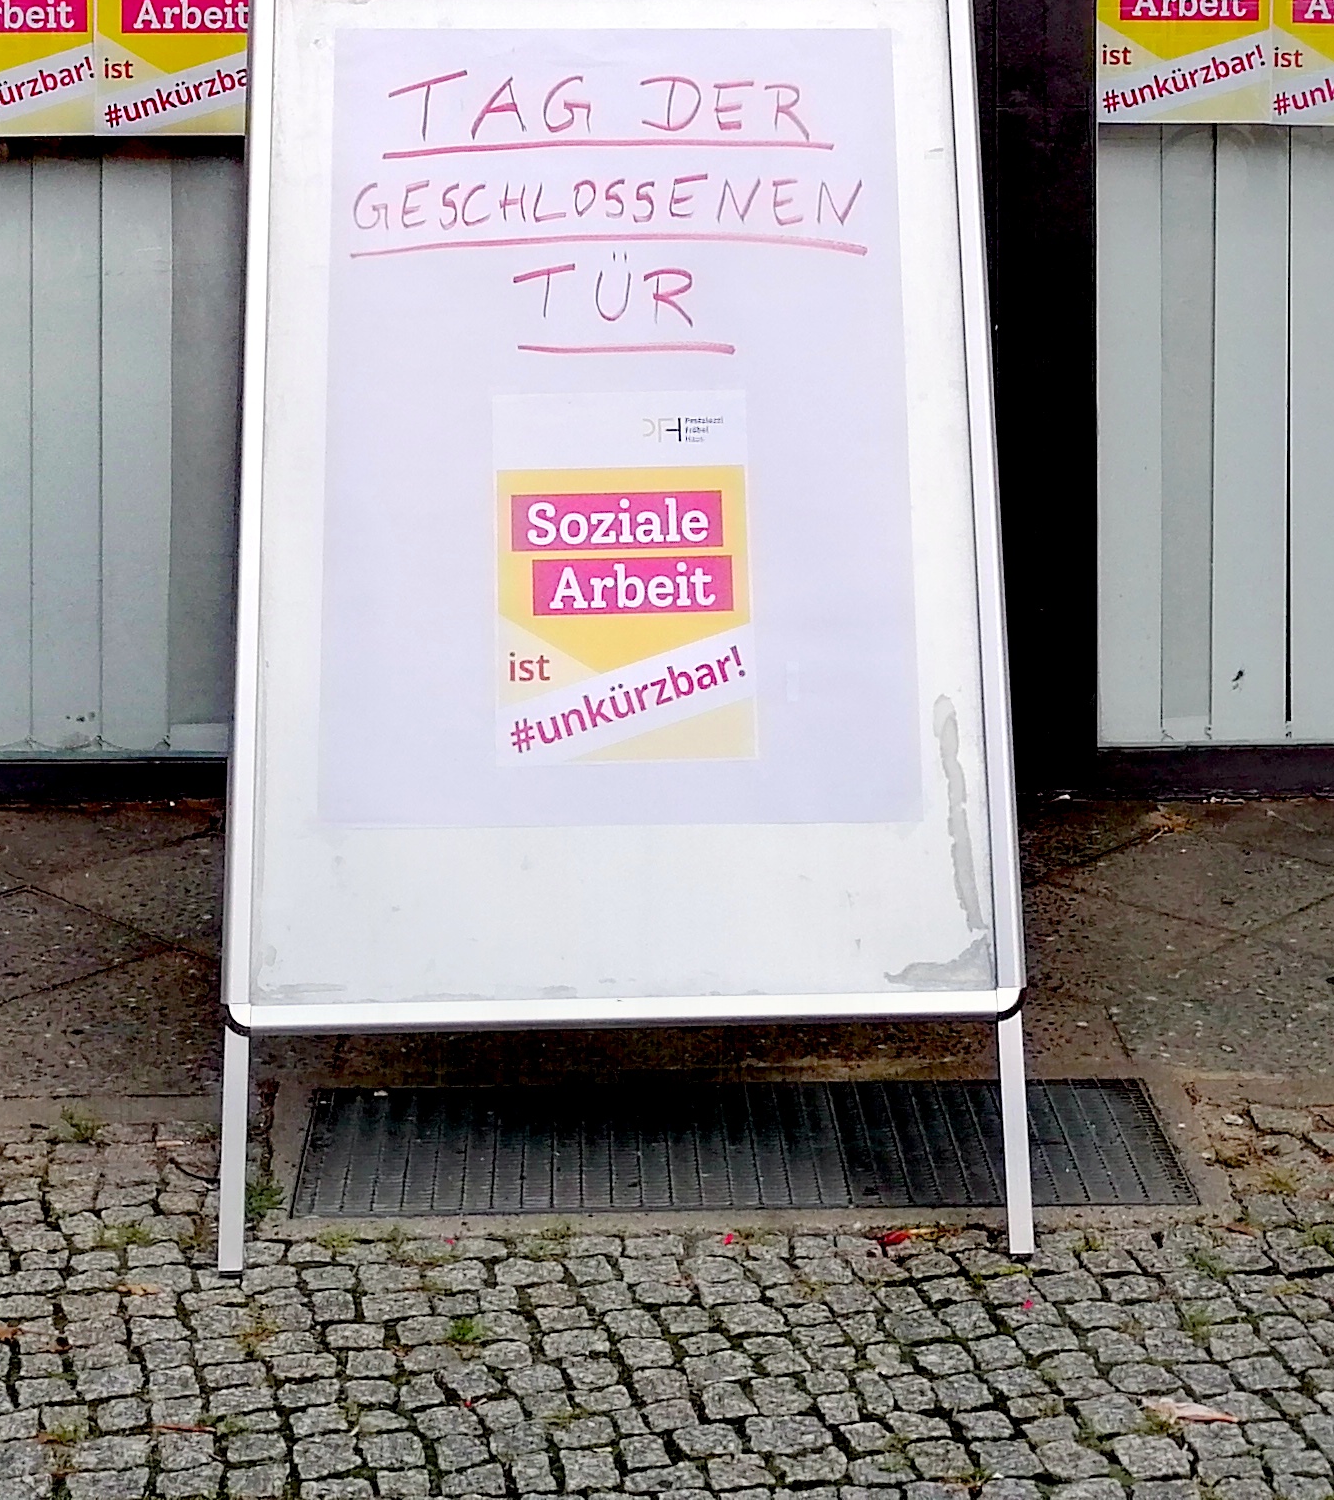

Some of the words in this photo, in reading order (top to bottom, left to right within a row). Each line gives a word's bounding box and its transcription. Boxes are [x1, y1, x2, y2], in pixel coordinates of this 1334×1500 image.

[104, 57, 134, 79] ist
[1102, 43, 1132, 66] ist
[1102, 43, 1266, 114] #unkürzbar!
[1273, 46, 1304, 68] ist
[387, 69, 592, 142] TAG
[639, 75, 811, 142] DER
[352, 173, 863, 227] GESCHLOSSENEN
[512, 251, 694, 328] TÜR
[526, 497, 710, 546] Soziale
[548, 561, 717, 610] Arbeit
[509, 652, 552, 682] ist
[509, 645, 747, 754] #unkürzbar!
